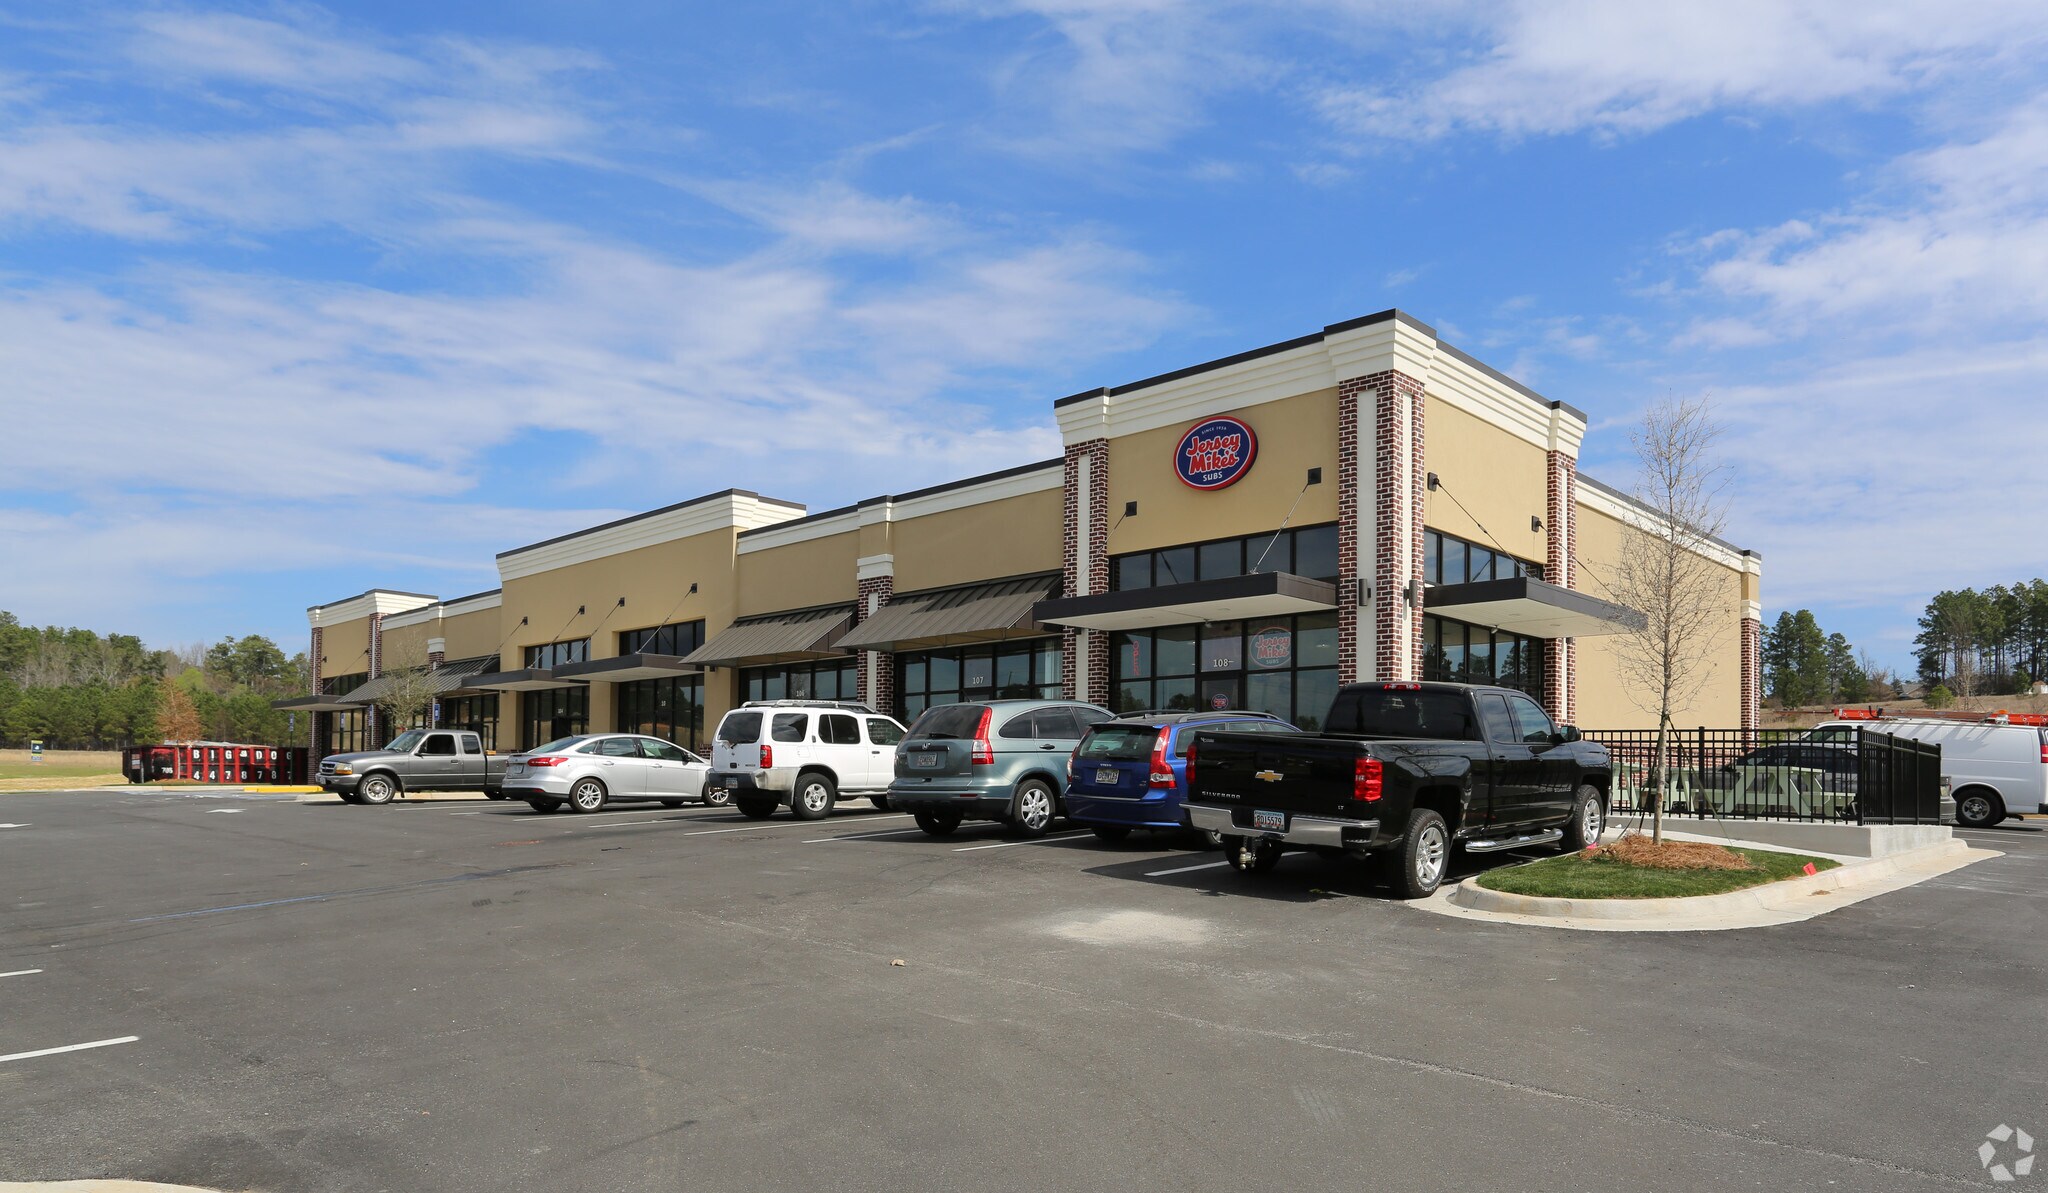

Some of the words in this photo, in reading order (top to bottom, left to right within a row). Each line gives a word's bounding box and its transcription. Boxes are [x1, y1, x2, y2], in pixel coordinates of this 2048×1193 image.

[1201, 427, 1214, 435] SINCE
[1186, 433, 1240, 457] Jersey
[1189, 450, 1239, 475] Mike's
[1203, 471, 1223, 482] SUBS
[1255, 635, 1290, 648] Jersey
[1213, 658, 1229, 668] 108
[972, 676, 984, 684] 107
[193, 749, 232, 760] BIG
